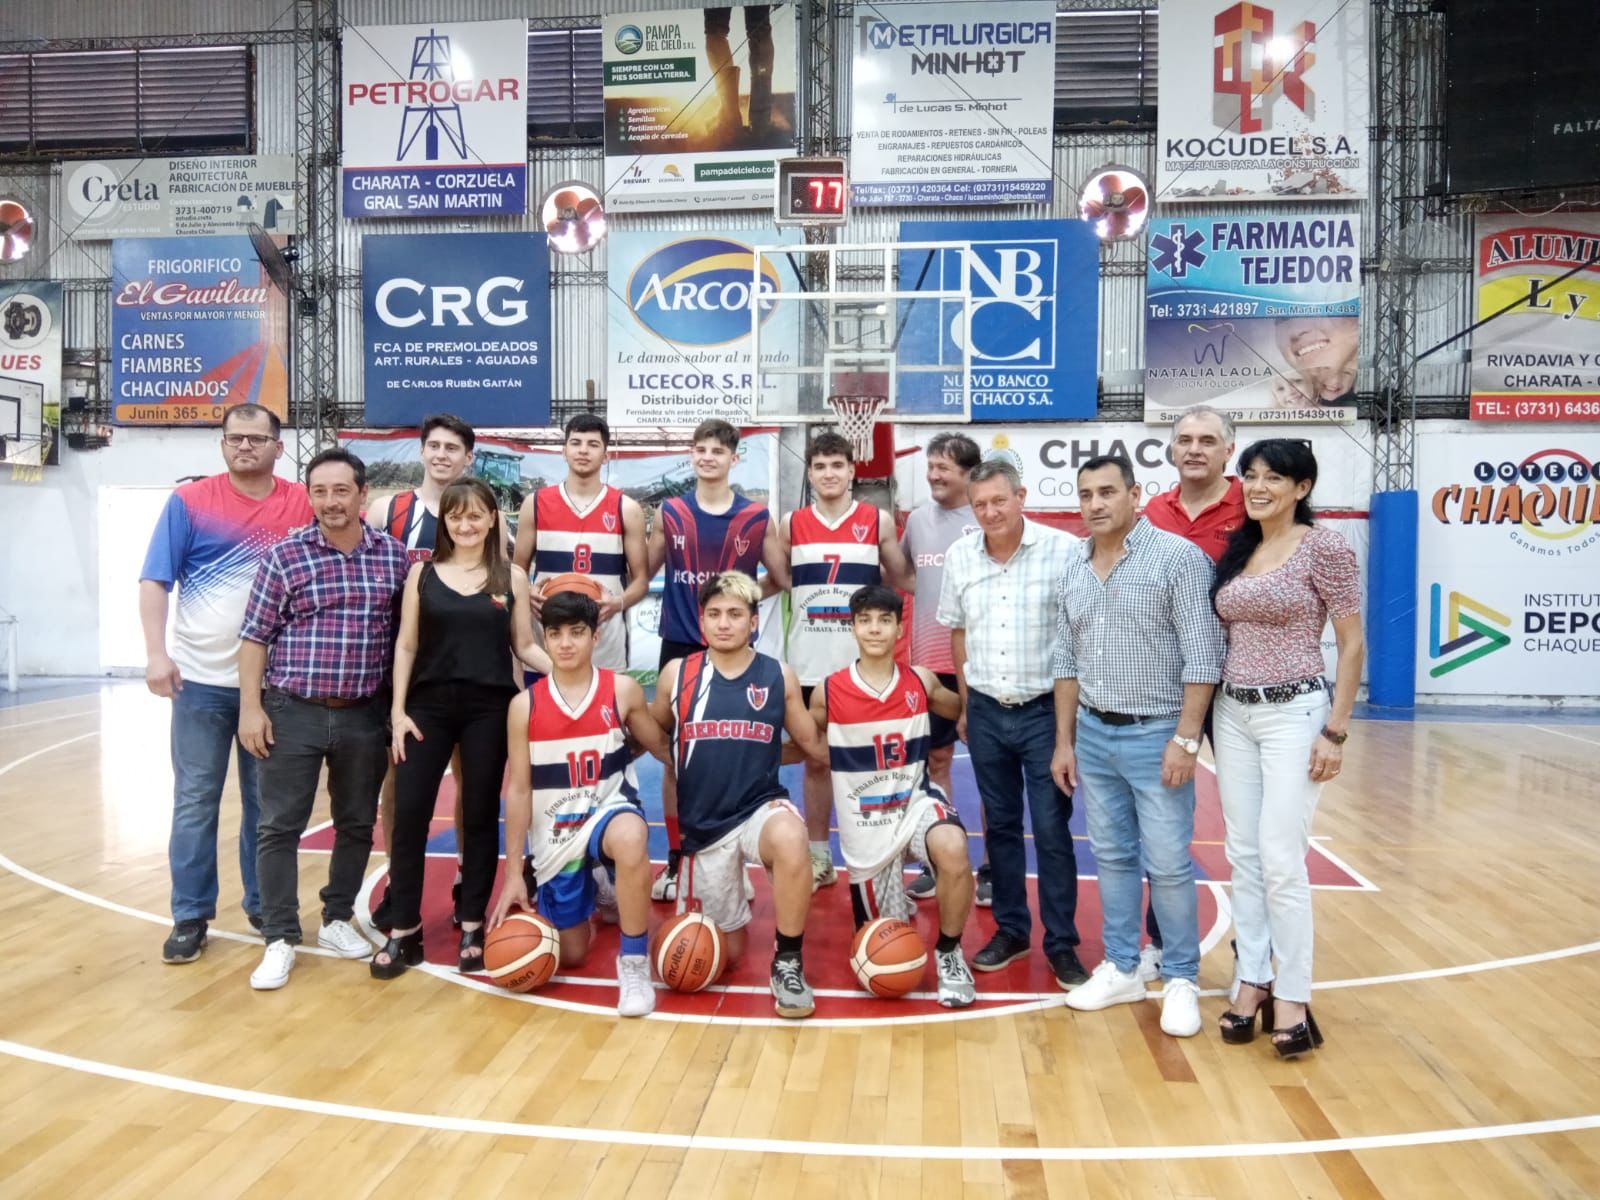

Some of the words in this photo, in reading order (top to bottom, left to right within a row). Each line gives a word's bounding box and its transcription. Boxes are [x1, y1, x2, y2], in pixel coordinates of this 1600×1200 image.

[645, 24, 681, 41] PAMPA
[872, 22, 1051, 48] METALURGICA
[646, 41, 660, 52] DEL
[661, 39, 682, 51] CIELO
[611, 64, 642, 73] SIEMPRE
[643, 64, 659, 72] CON
[660, 63, 675, 71] LOS
[911, 50, 1026, 76] MINHOT
[611, 73, 628, 82] PIES
[628, 72, 653, 81] SOBRE
[653, 71, 664, 79] LA
[348, 78, 519, 106] PETROGAR
[899, 104, 914, 113] de
[916, 104, 952, 113] Lucas
[955, 103, 967, 112] S.
[969, 102, 1008, 112] Minhot
[857, 130, 880, 139] VENTA
[881, 130, 891, 138] DE
[892, 129, 943, 138] RODAMIENTOS
[949, 128, 982, 137] RETENES
[987, 127, 1000, 136] SIN
[1000, 127, 1012, 136] FIN
[1018, 127, 1048, 136] POLEAS
[878, 142, 926, 151] ENGRANAJES
[931, 141, 974, 150] REPUESTOS
[975, 138, 1023, 149] CARDÁNICOS
[1166, 137, 1301, 158] KOCUDEL
[1311, 136, 1358, 155] S.A.
[169, 158, 207, 171] DISEÑO
[209, 158, 257, 170] INTERIOR
[897, 154, 952, 163] REPARACIONES
[954, 151, 1002, 162] HIDRÁULICAS
[1165, 160, 1231, 172] MATERIALES
[1231, 159, 1260, 170] PARA
[1261, 159, 1276, 170] LA
[1276, 157, 1360, 170] CONSTRUCCIÓN
[169, 171, 248, 183] ARQUITECTURA
[881, 165, 929, 176] FABRICACIÓN
[930, 166, 940, 175] EN
[942, 166, 976, 175] GENERAL
[982, 163, 1018, 174] TORNERÍA
[82, 176, 160, 202] Creta
[169, 182, 237, 194] FABRICACIÓN
[239, 182, 253, 192] DE
[352, 174, 420, 190] CHARATA
[435, 173, 516, 189] CORZUELA
[888, 185, 920, 195] (03731)
[954, 184, 972, 192] Cel:
[364, 195, 403, 210] GRAL
[407, 194, 440, 209] SAN
[444, 193, 503, 208] MARTIN
[810, 181, 843, 210] 77
[175, 206, 232, 215] 3731-400719
[1211, 220, 1355, 251] FARMACIA
[148, 258, 242, 274] FRIGORIFICO
[1240, 255, 1353, 285] TEJEDOR
[116, 279, 152, 306] El
[152, 278, 268, 305] Gavilan
[634, 272, 774, 311] ARCOR
[1526, 278, 1552, 310] L
[1564, 293, 1587, 320] y
[375, 275, 529, 328] CRG
[140, 311, 173, 321] VENTAS
[174, 311, 193, 320] POR
[194, 311, 224, 320] MAYOR
[226, 311, 233, 320] Y
[234, 310, 266, 320] MENOR
[1150, 304, 1173, 318] Tel:
[1177, 302, 1259, 317] 3731-421897
[1265, 305, 1287, 315] San
[121, 333, 185, 350] CARNES
[374, 342, 402, 353] FCA
[405, 342, 423, 353] DE
[426, 341, 538, 352] PREMOLDEADOS
[121, 356, 202, 374] FIAMBRES
[374, 355, 402, 367] ART.
[405, 355, 463, 366] RURALES
[475, 355, 538, 366] AGUADAS
[617, 352, 633, 364] Le
[637, 351, 681, 364] damos
[684, 351, 720, 364] sabor
[724, 351, 739, 364] al
[1486, 354, 1575, 368] RIVADAVIA
[1579, 354, 1591, 367] Y
[1148, 366, 1213, 378] NATALIA
[1220, 366, 1273, 378] LAOLA
[628, 373, 714, 390] LICECOR
[722, 373, 777, 389] S.R.L.
[998, 373, 1049, 388] BANCO
[1503, 374, 1583, 388] CHARATA
[121, 380, 230, 398] CHACINADOS
[641, 394, 720, 406] Distribuidor
[722, 394, 764, 406] Oficil
[972, 392, 1025, 406] CHACO
[1028, 392, 1053, 406] S.A.
[173, 406, 198, 420] 365
[1258, 409, 1345, 422] (3731)15439116
[1476, 402, 1511, 416] TEL:
[1515, 401, 1560, 418] (3731)
[1476, 461, 1600, 481] LOTER
[672, 534, 686, 550] 14
[1509, 530, 1562, 557] Ganamos
[572, 543, 592, 574] 8
[822, 553, 842, 585] 7
[684, 719, 775, 744] HERCULES
[872, 731, 907, 771] 13
[566, 748, 601, 788] 10
[668, 937, 690, 982] molten
